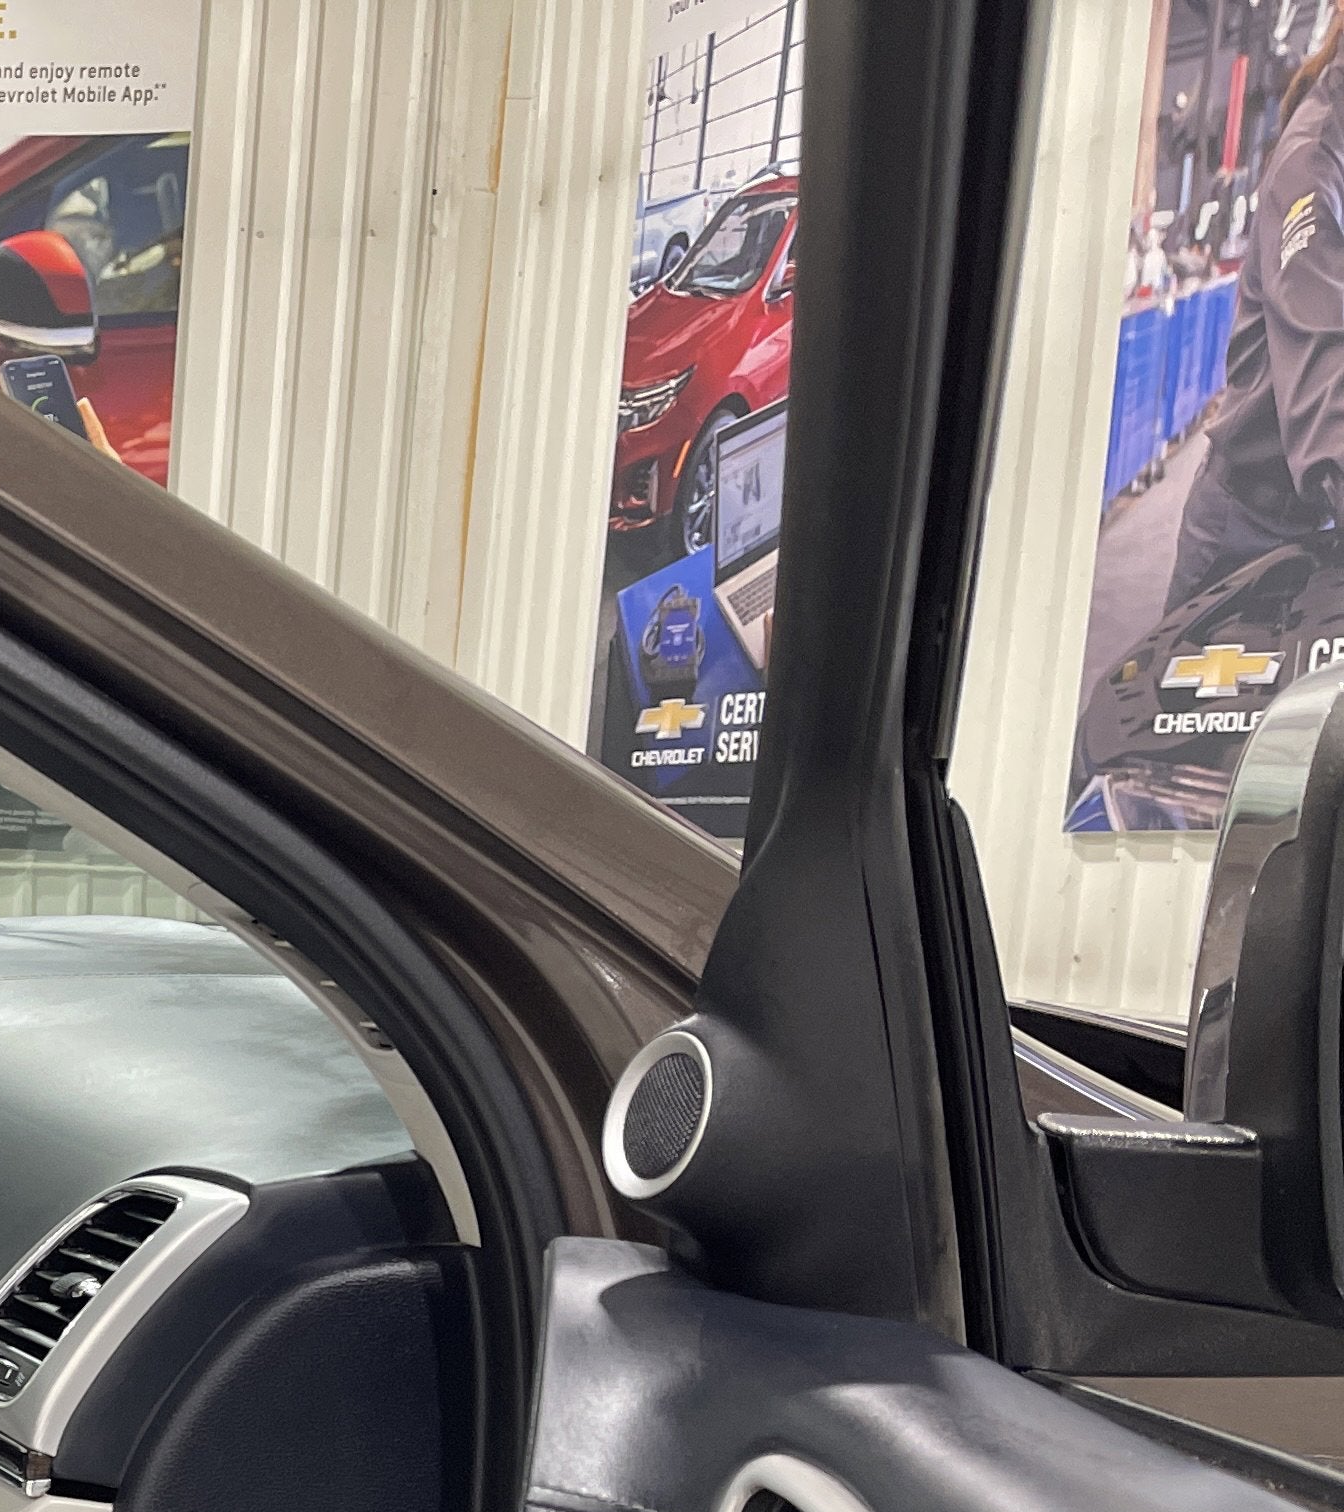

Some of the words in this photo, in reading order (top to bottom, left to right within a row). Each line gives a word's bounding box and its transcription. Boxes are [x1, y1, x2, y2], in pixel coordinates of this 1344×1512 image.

[29, 62, 74, 83] enjoy
[80, 63, 140, 79] remote
[63, 86, 116, 103] Mobile
[630, 748, 705, 768] CHEVROLET
